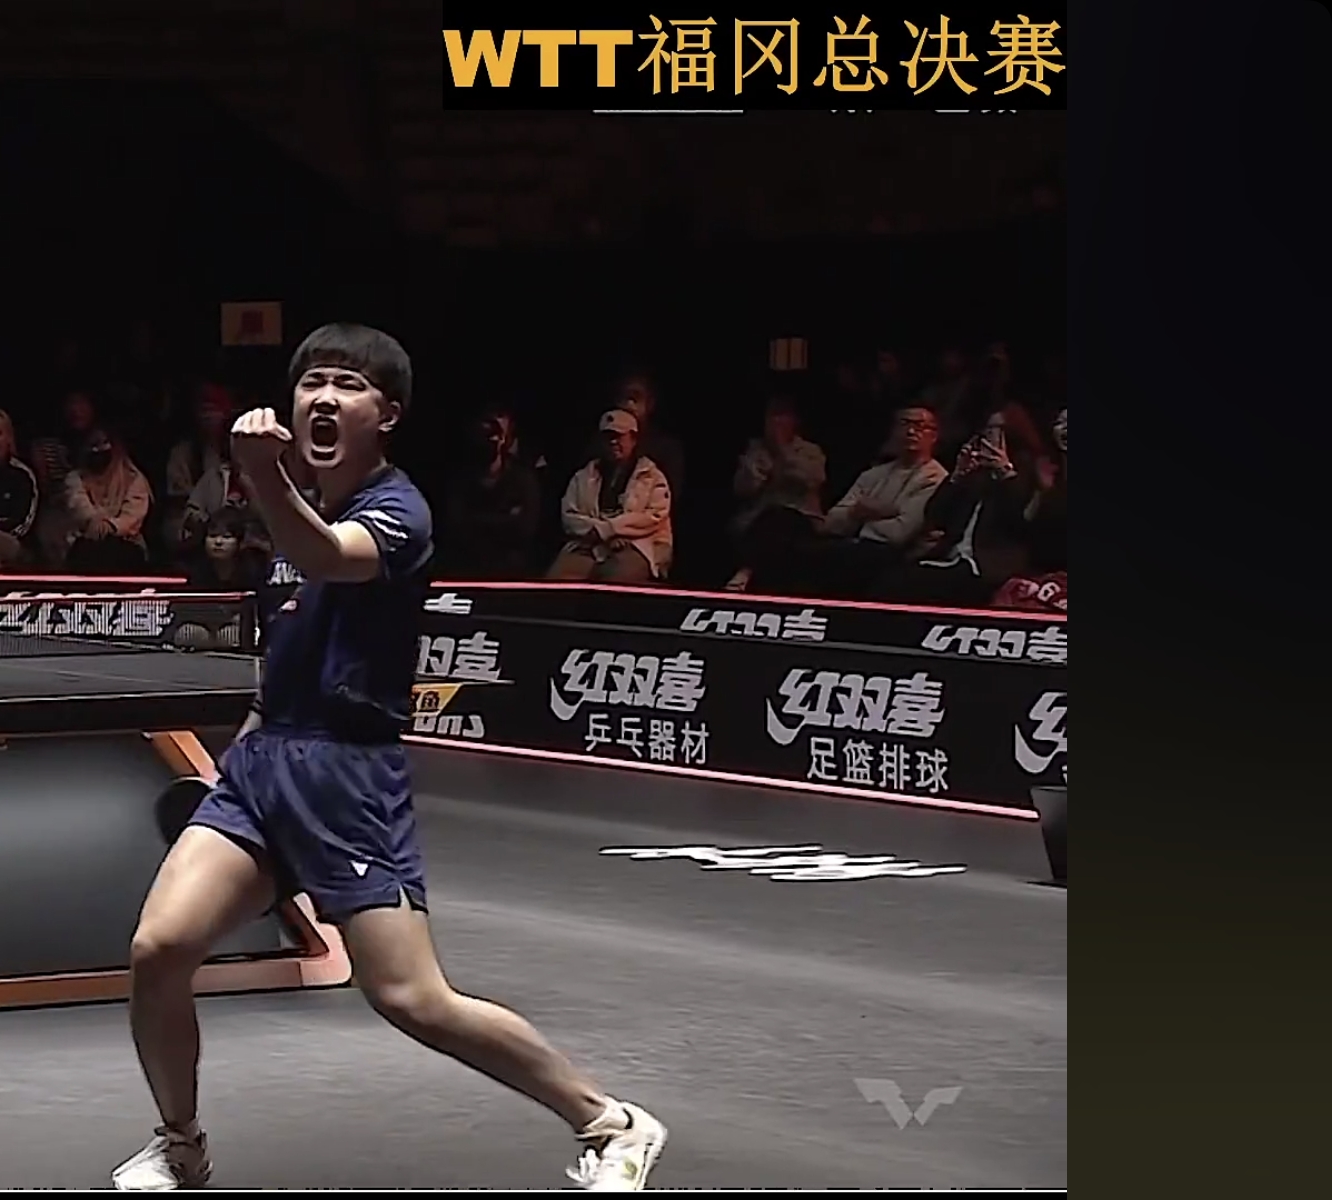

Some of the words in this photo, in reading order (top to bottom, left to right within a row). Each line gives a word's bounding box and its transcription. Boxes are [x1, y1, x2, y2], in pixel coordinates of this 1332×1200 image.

[550, 651, 707, 721] 红双喜
[766, 672, 946, 746] 红双喜
[584, 713, 711, 765] 乒乓器材
[806, 736, 950, 794] 足篮排球
